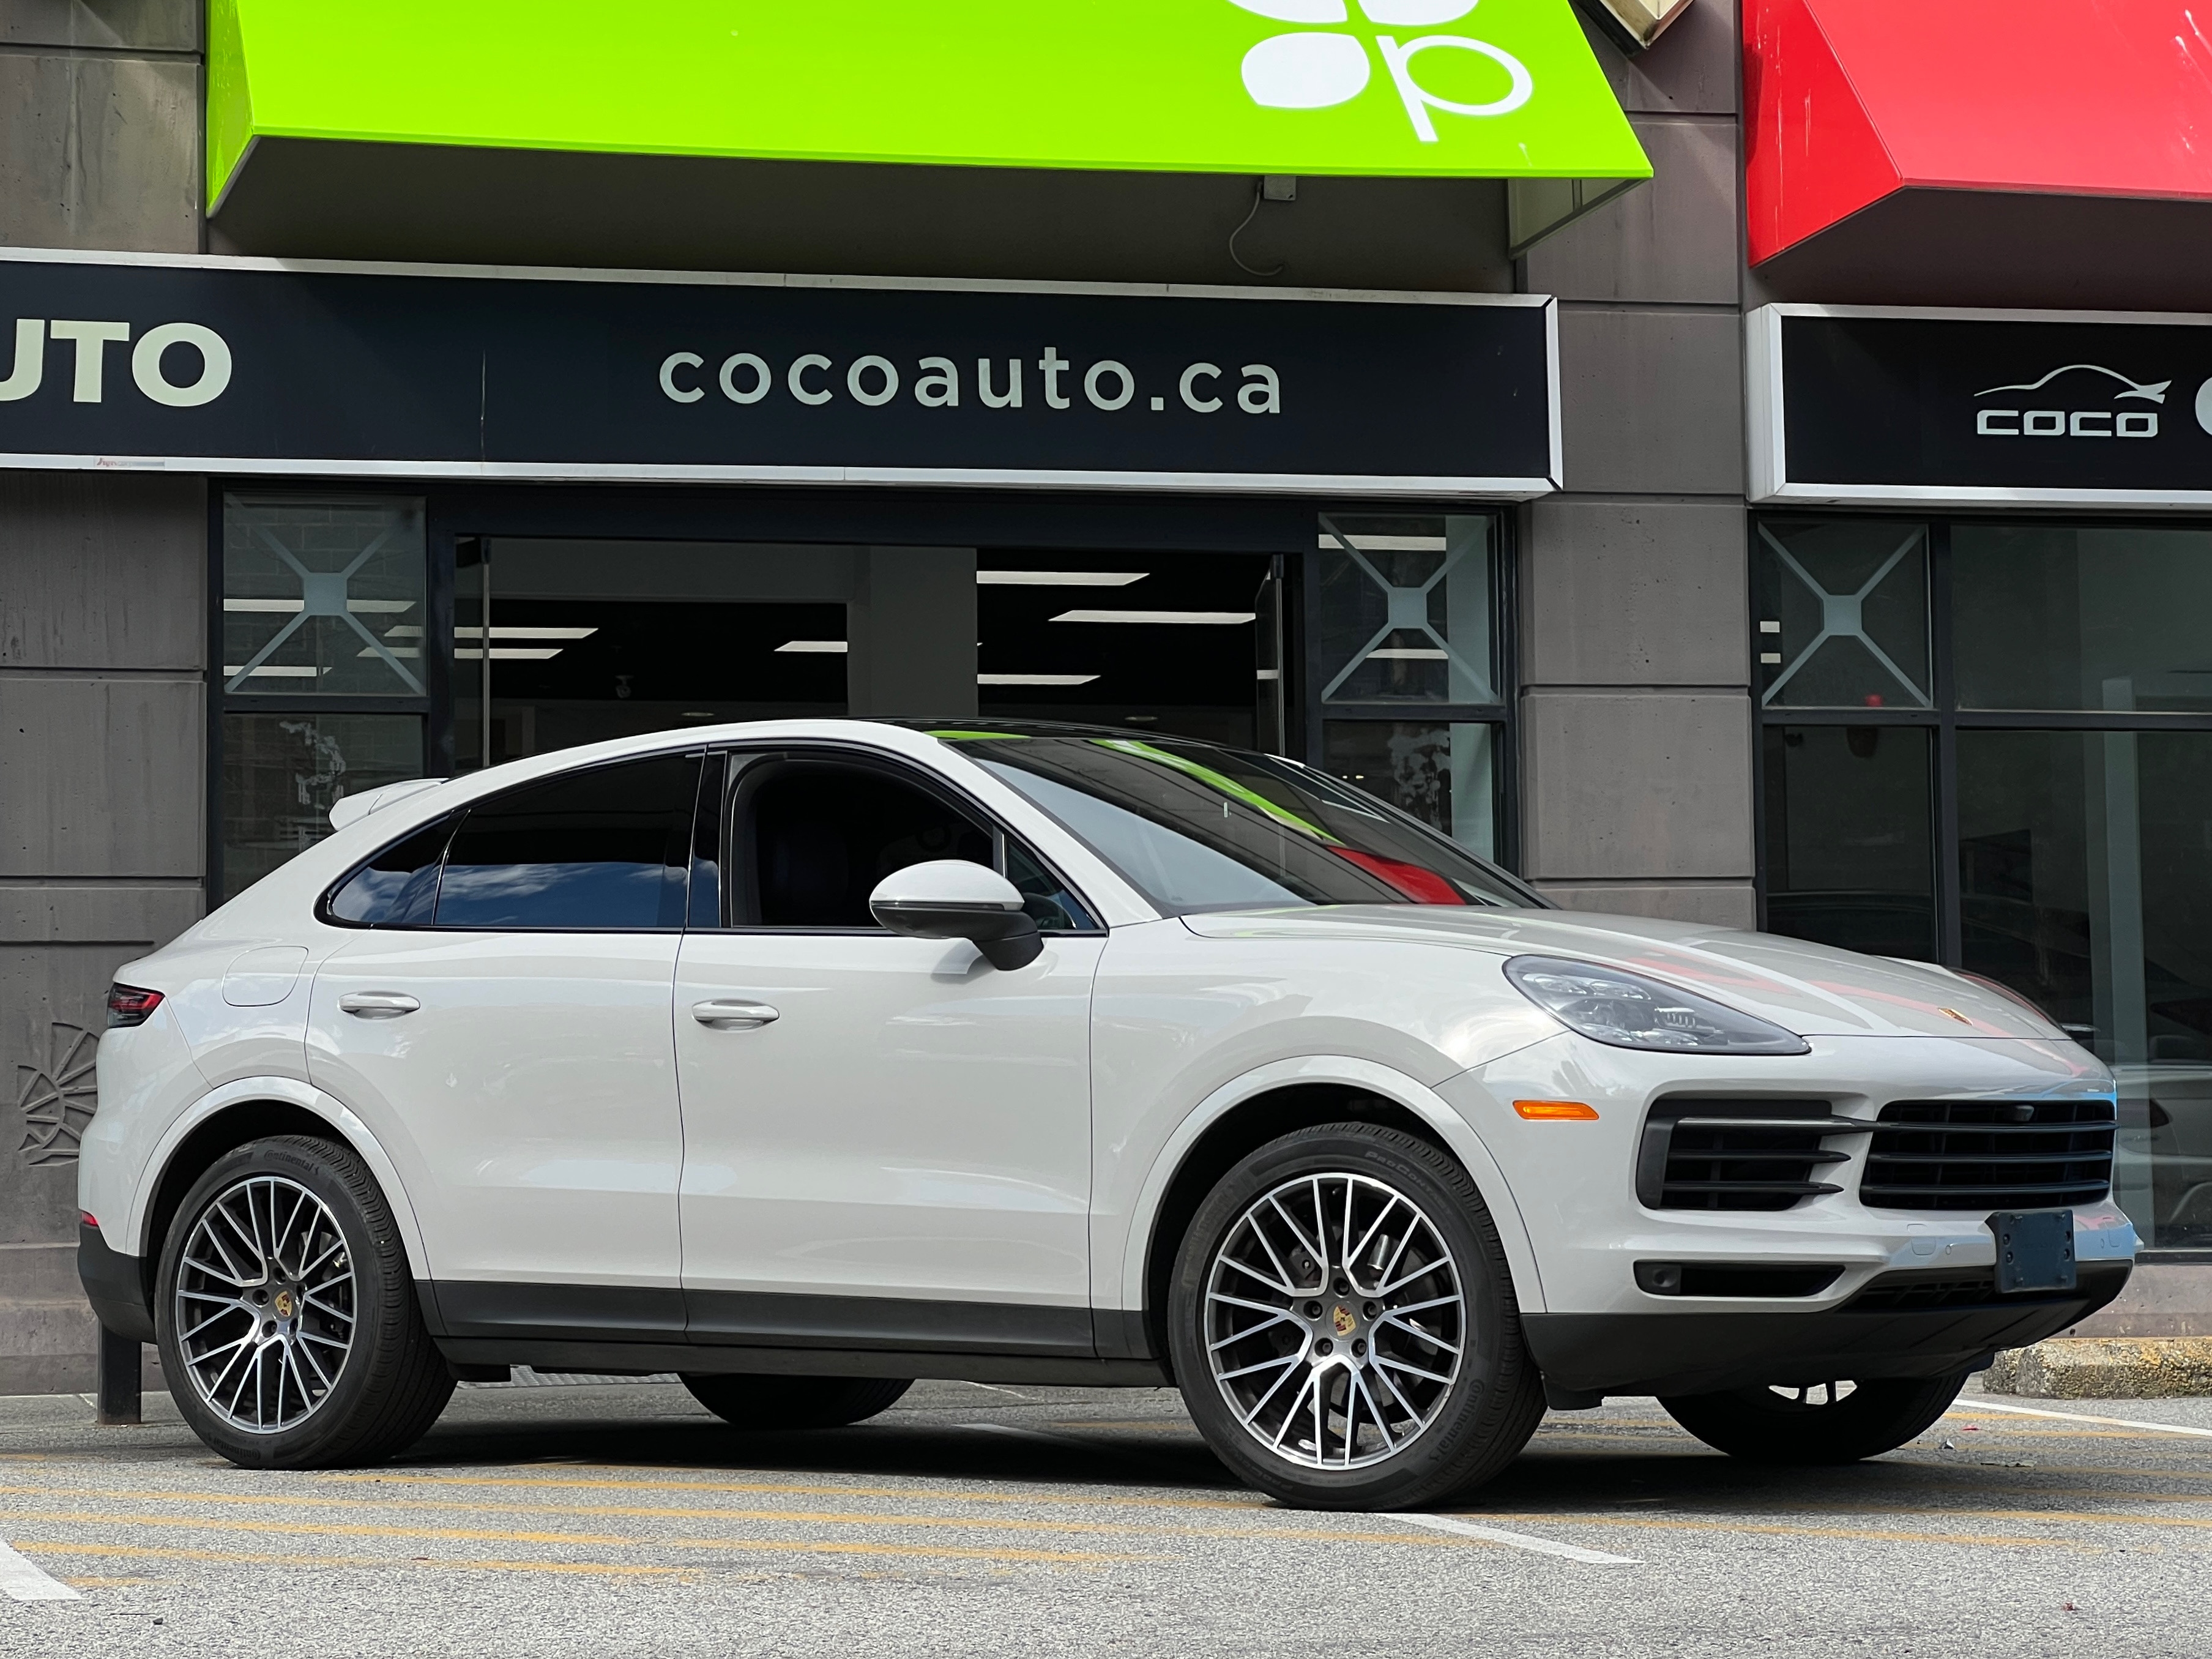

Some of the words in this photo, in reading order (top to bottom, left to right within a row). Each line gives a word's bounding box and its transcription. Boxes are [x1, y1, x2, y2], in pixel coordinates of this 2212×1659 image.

[658, 346, 1280, 414] cocoauto.ca
[1976, 409, 2158, 438] COCO
[1438, 1378, 1484, 1455] Continental
